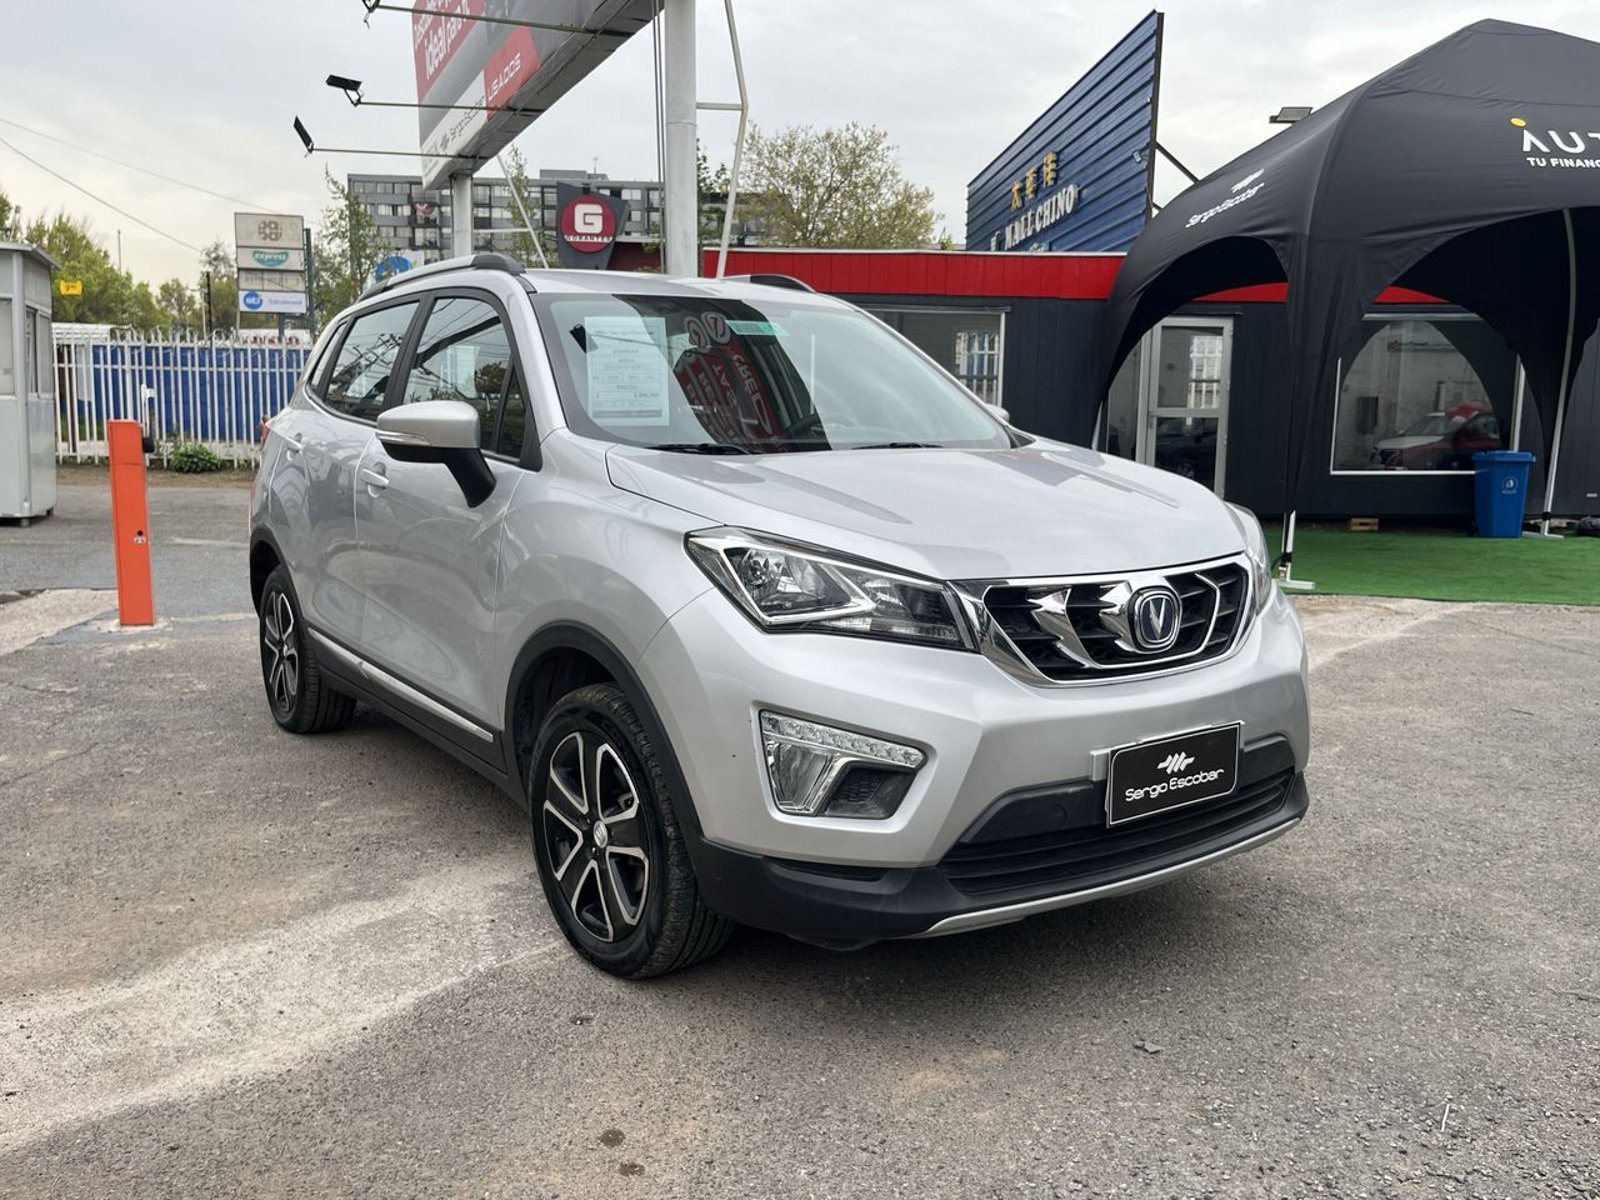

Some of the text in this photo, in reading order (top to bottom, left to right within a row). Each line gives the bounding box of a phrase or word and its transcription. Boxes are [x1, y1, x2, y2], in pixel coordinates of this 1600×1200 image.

[487, 52, 521, 102] USADOS
[1526, 157, 1547, 167] TU
[574, 203, 603, 234] G
[1034, 183, 1077, 233] CHINO
[1169, 768, 1225, 790] Escobar
